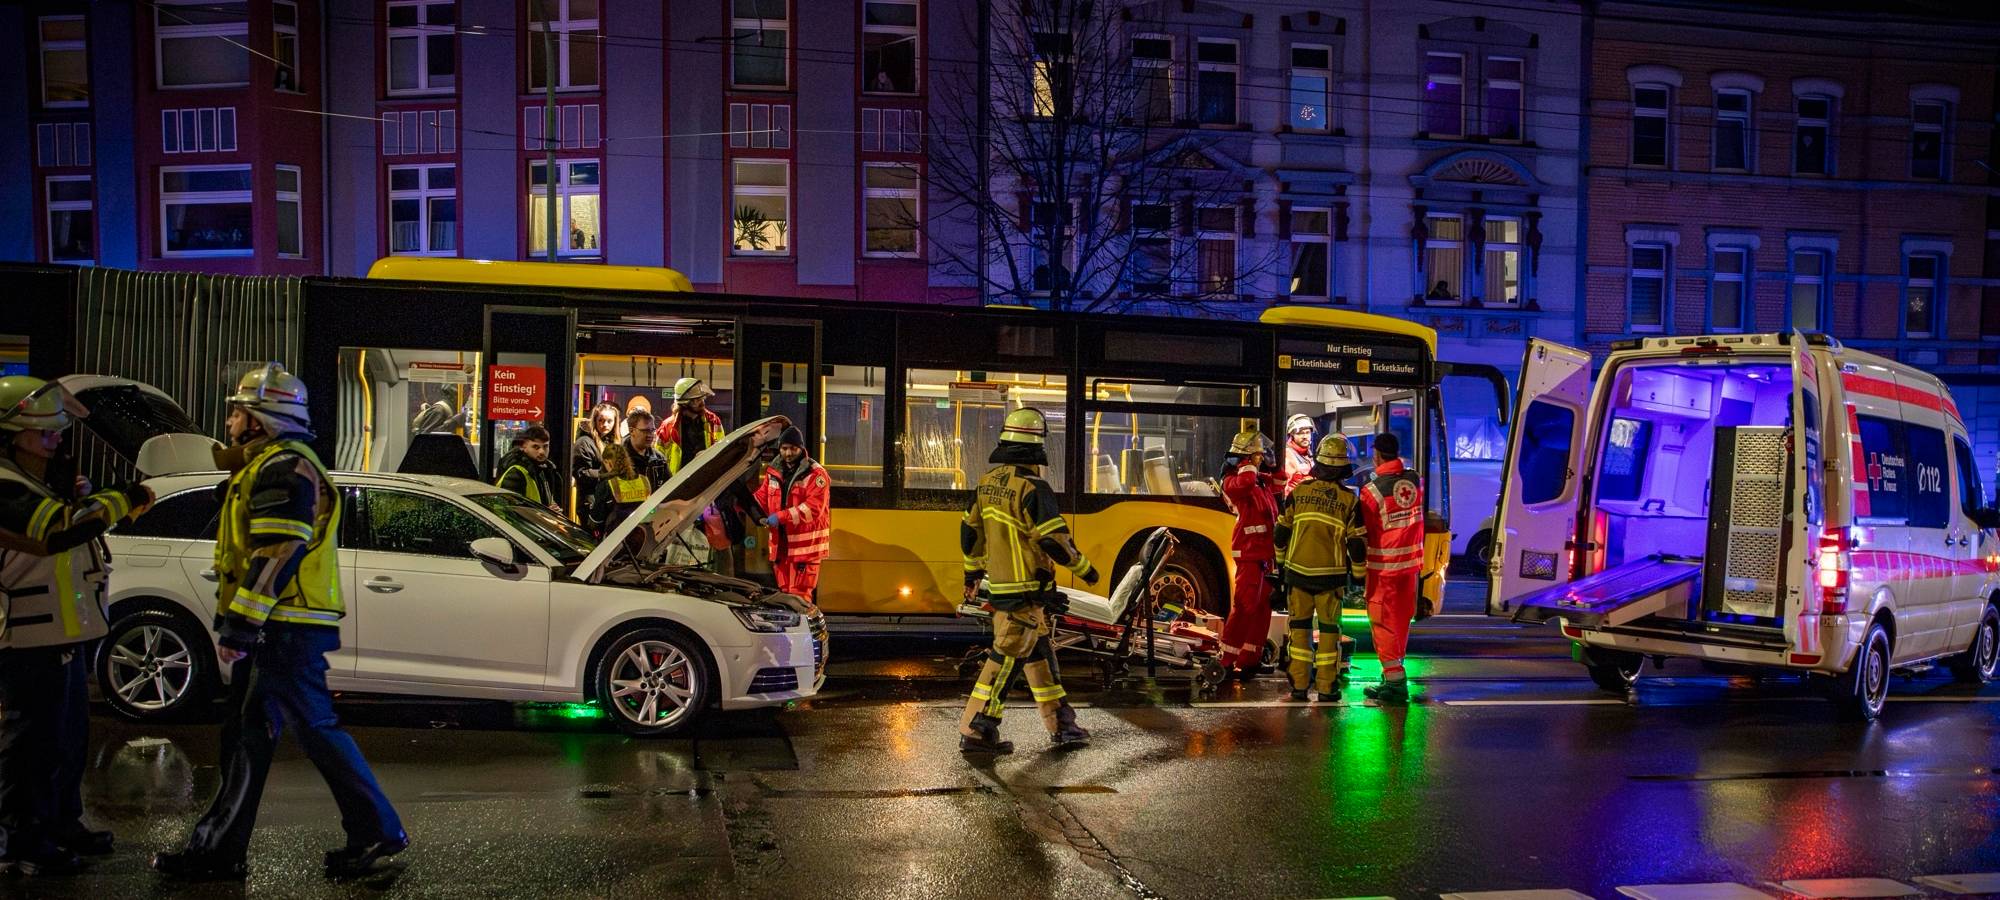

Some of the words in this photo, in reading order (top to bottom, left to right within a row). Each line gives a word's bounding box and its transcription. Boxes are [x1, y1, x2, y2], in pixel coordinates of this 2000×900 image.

[1327, 344, 1341, 353] Nur
[1343, 345, 1372, 357] Einstieg
[1292, 359, 1341, 369] Ticketinhaber
[1372, 363, 1415, 374] Ticketkäufer
[494, 370, 516, 380] Kein
[494, 383, 536, 396] Einstieg!
[493, 396, 509, 404] Bitte
[492, 405, 527, 416] einsteigen
[1881, 453, 1905, 467] Deutsches
[1882, 466, 1896, 479] Rotes
[1926, 465, 1941, 493] 112
[1883, 479, 1897, 492] Kreuz
[1295, 495, 1346, 512] FEUERWEHR
